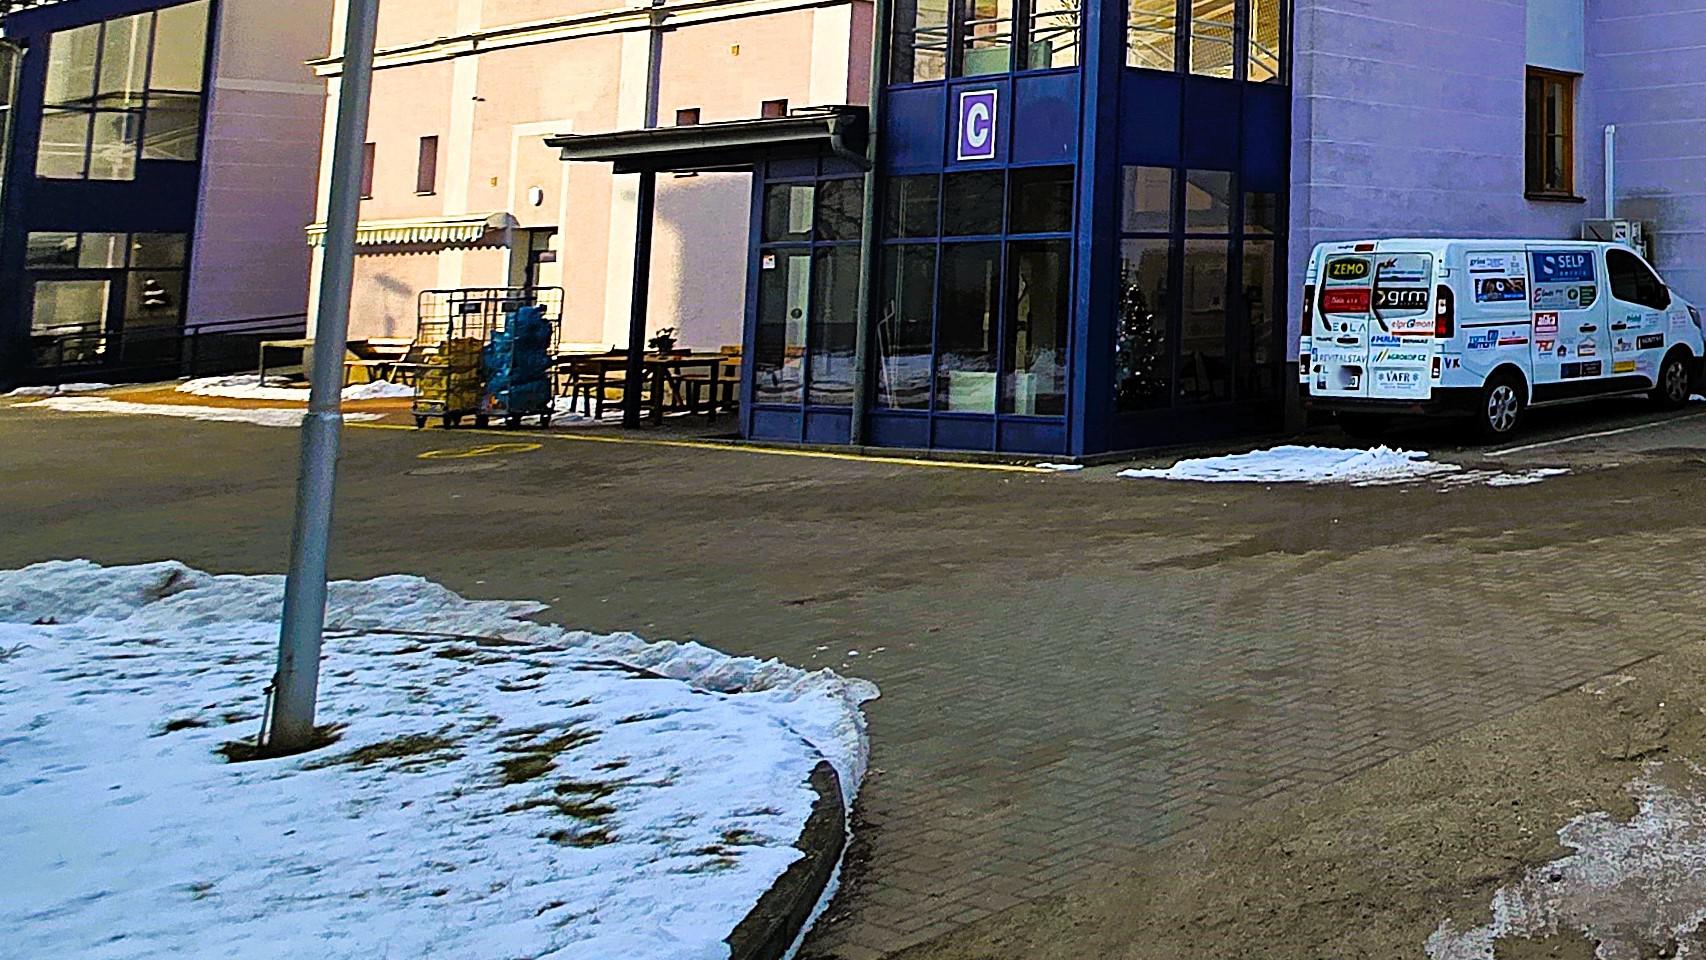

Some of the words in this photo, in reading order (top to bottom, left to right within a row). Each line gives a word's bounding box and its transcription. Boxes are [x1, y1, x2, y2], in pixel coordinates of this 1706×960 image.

[966, 102, 989, 148] C
[1558, 255, 1585, 268] SELP
[1333, 263, 1364, 275] ZEMO
[1387, 290, 1428, 306] grm
[1418, 354, 1427, 362] CZ
